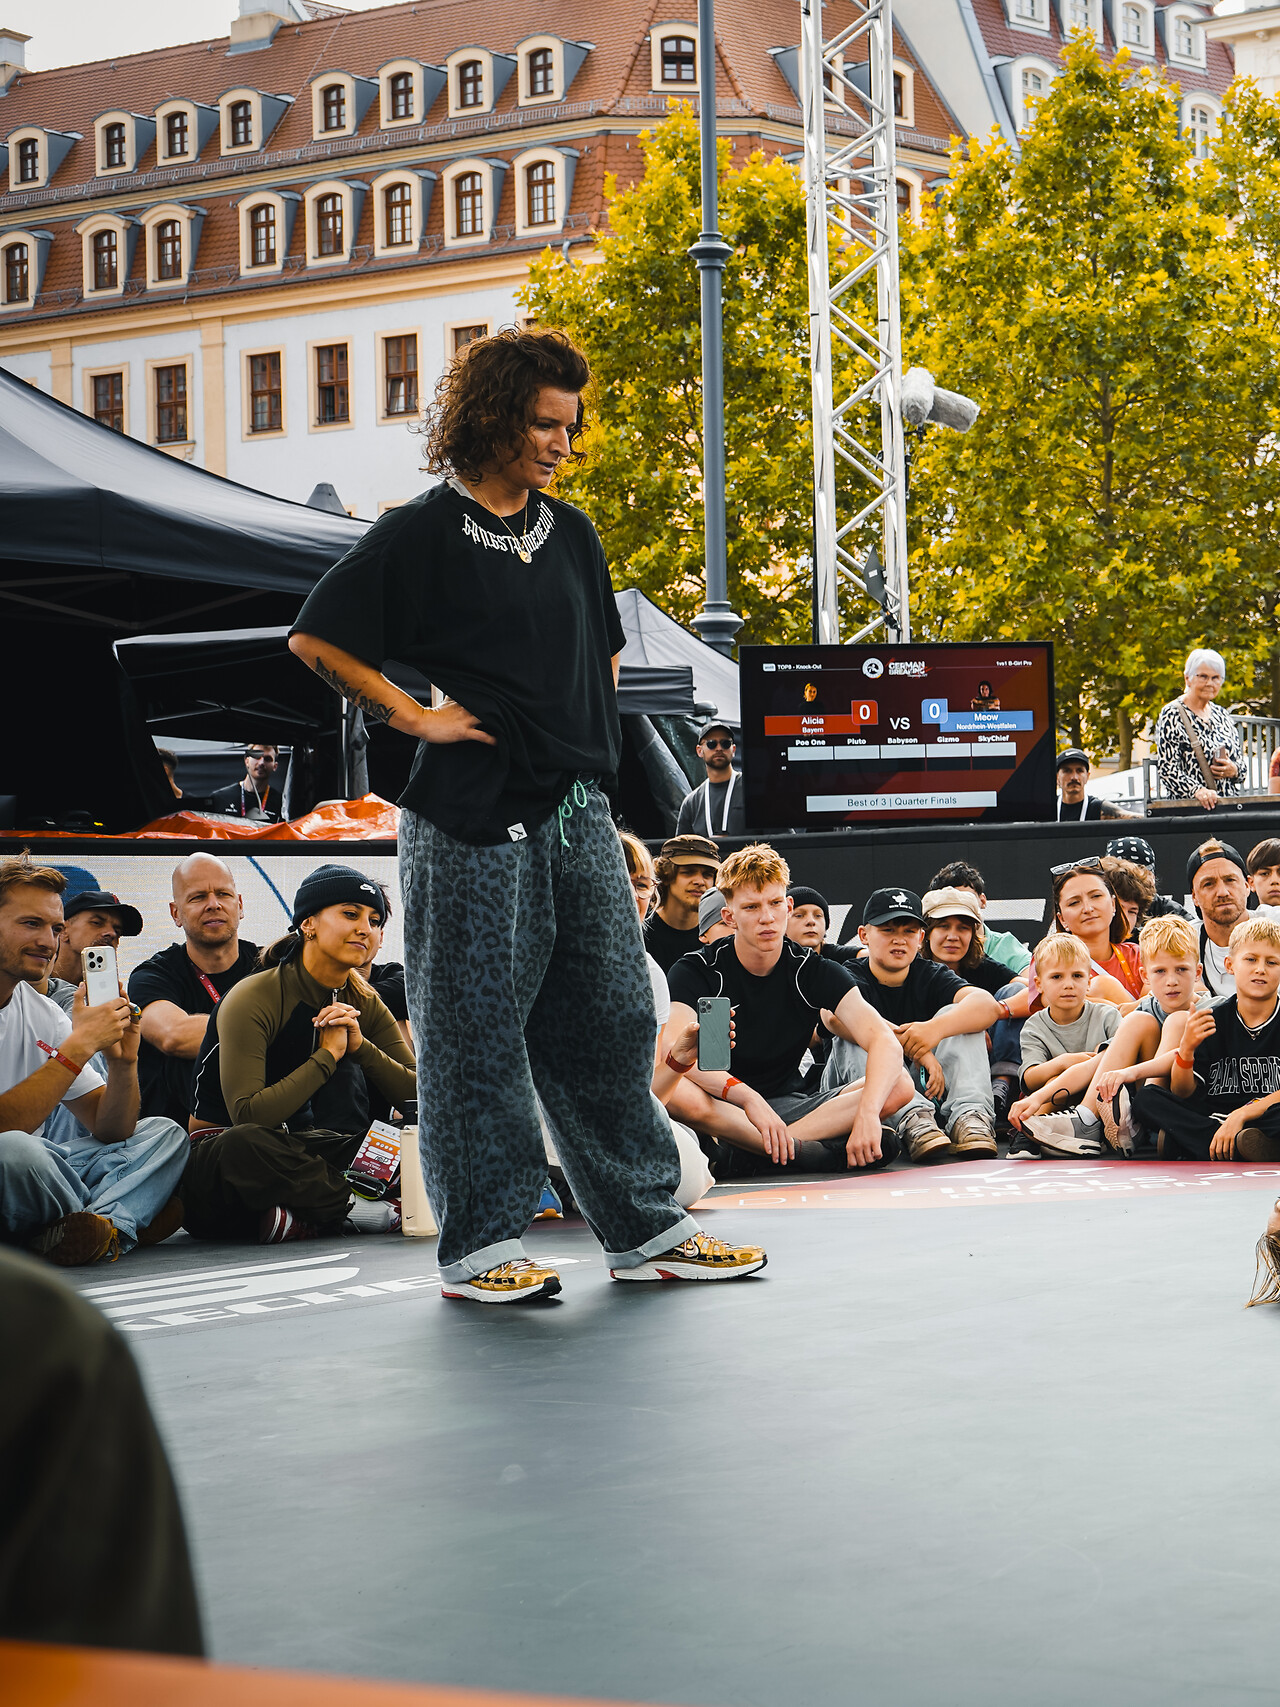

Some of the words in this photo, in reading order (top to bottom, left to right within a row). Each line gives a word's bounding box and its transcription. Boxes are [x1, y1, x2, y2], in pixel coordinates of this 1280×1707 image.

[888, 661, 925, 669] GERMAN
[859, 704, 870, 720] 0
[929, 703, 941, 719] 0
[801, 716, 824, 725] Alicia
[974, 713, 998, 722] Meow
[889, 717, 911, 731] VS
[956, 723, 1017, 731] Nordrhein-Westfalen
[802, 726, 824, 735] Bayern
[887, 737, 918, 745] Babyson
[978, 735, 1010, 743] SkyChief
[847, 798, 867, 807] Best
[870, 798, 878, 806] of
[881, 798, 887, 806] 3
[894, 797, 928, 807] Quarter
[930, 796, 957, 806] Finals
[738, 1192, 864, 1207] DIE
[890, 1175, 1178, 1197] FINALS
[949, 1180, 1213, 1199] DRESDEN
